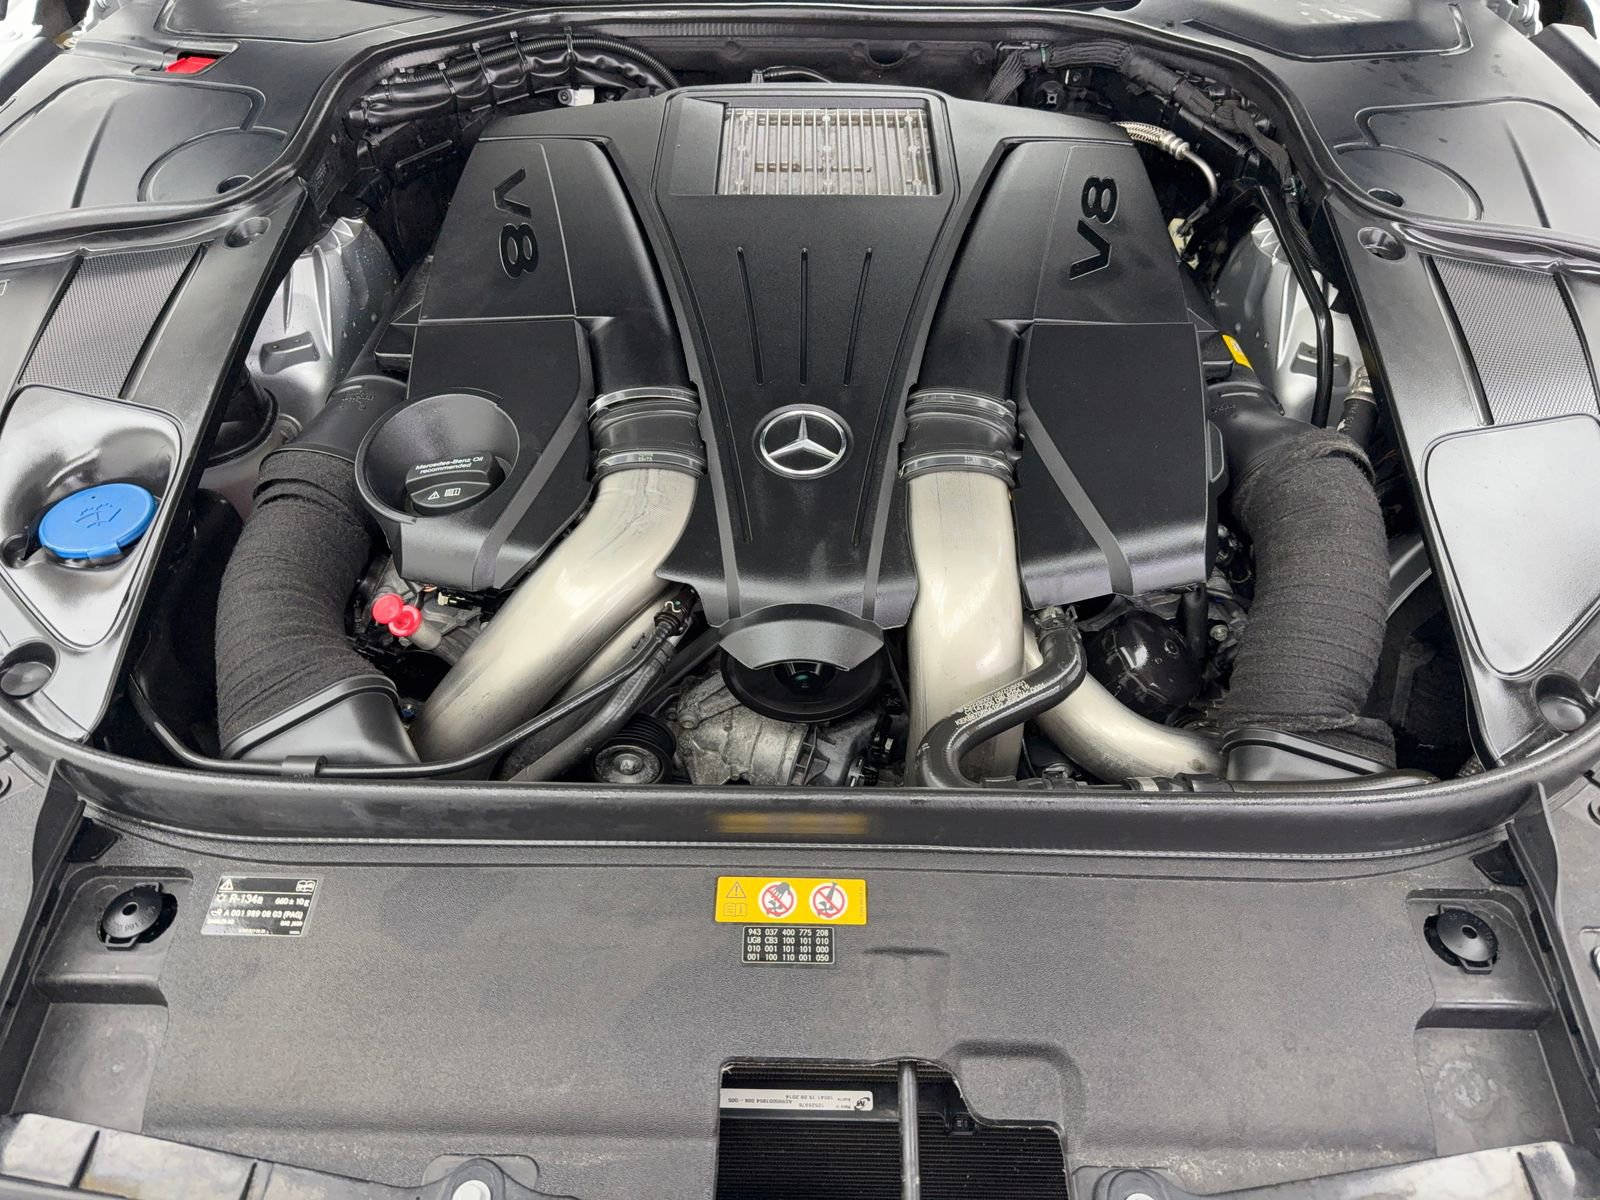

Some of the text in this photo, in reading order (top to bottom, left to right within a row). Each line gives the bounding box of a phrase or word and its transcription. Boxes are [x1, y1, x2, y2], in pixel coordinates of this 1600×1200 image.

[493, 167, 539, 279] V8
[1069, 175, 1119, 281] V8
[415, 457, 472, 471] Mercedes-Benz
[419, 463, 472, 474] recommended
[229, 893, 264, 905] R-134a
[223, 909, 230, 917] A
[231, 909, 244, 917] 001
[246, 910, 261, 918] 989
[272, 910, 283, 919] 03
[282, 911, 304, 920] (PAG)
[747, 928, 761, 936] 943
[764, 928, 778, 936] 037
[782, 928, 796, 936] 400
[815, 929, 829, 937] 208
[783, 936, 796, 944] 100
[815, 937, 829, 945] 010
[800, 945, 811, 953] 101
[747, 953, 760, 961] 001
[765, 953, 778, 961] 100
[783, 953, 796, 961] 110
[815, 954, 829, 962] 050
